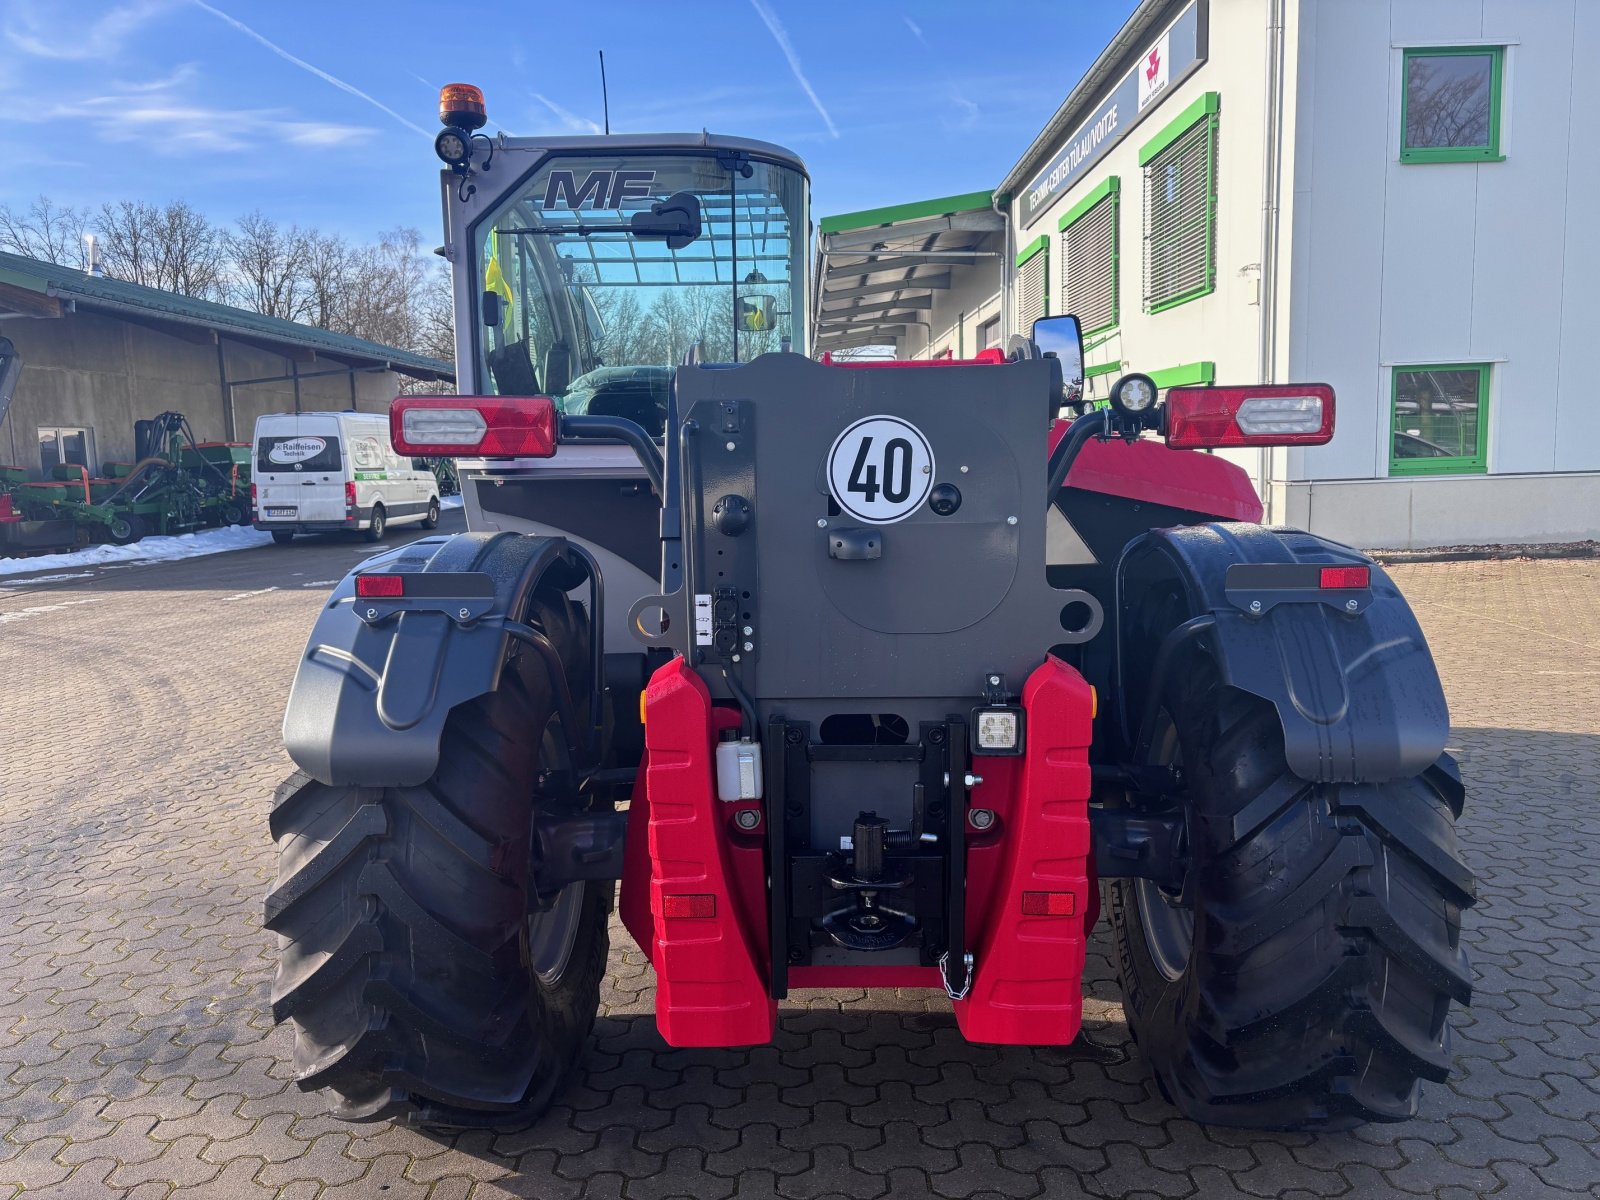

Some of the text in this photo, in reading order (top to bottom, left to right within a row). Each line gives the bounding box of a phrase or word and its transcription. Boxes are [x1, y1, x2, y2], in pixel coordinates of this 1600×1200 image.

[541, 170, 657, 210] MF
[282, 443, 321, 451] Raiffeisen
[847, 436, 913, 504] 40
[1111, 885, 1138, 996] MICHELIN
